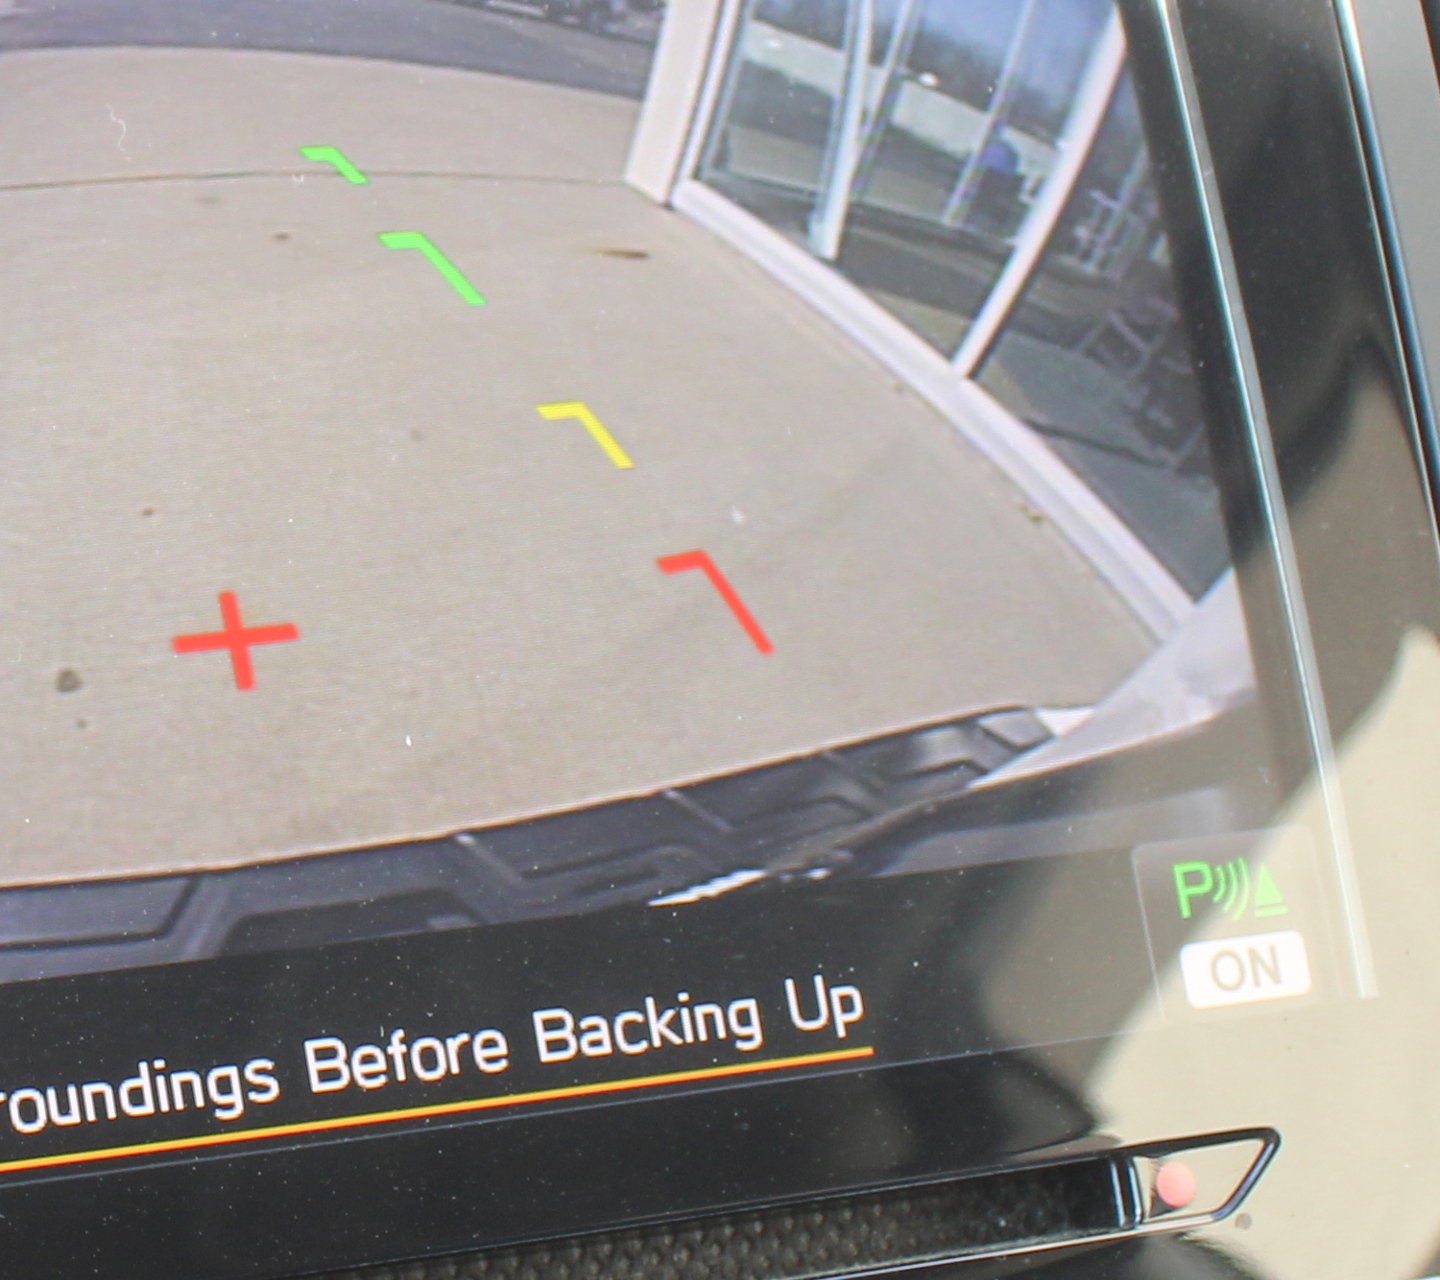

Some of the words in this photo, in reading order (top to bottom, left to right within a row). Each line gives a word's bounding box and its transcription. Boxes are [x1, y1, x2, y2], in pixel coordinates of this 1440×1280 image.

[1209, 942, 1283, 992] ON
[303, 1026, 510, 1094] Before
[531, 990, 764, 1064] Backing
[783, 973, 866, 1039] Up
